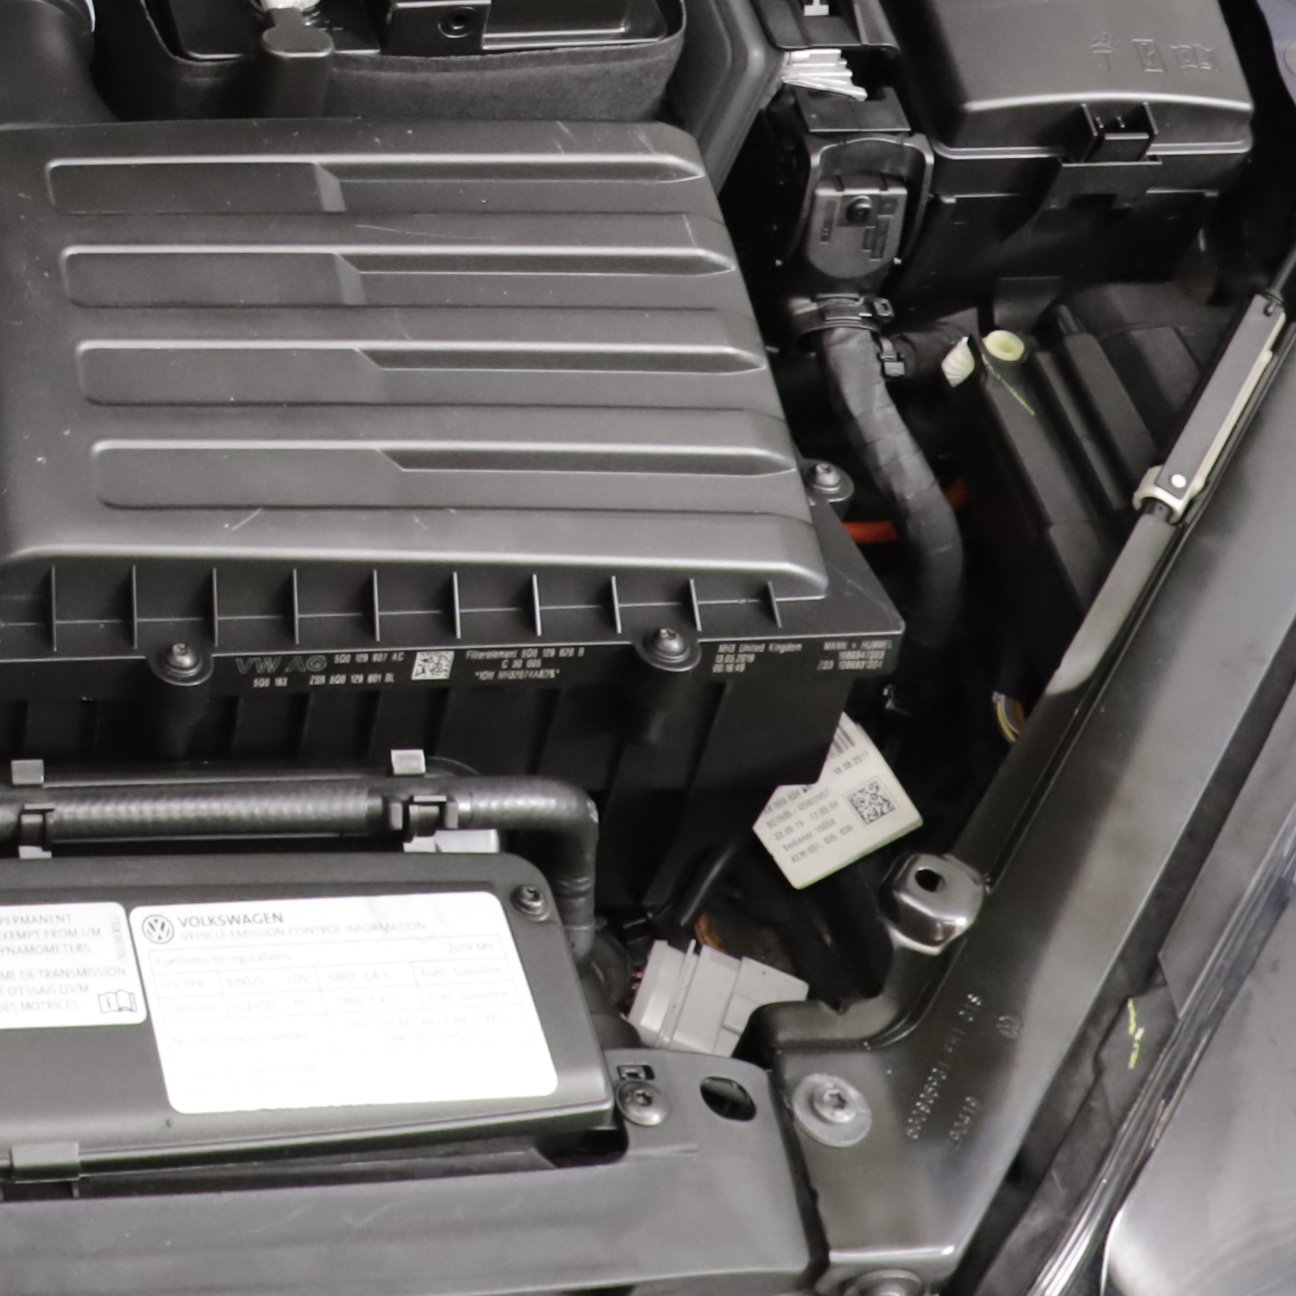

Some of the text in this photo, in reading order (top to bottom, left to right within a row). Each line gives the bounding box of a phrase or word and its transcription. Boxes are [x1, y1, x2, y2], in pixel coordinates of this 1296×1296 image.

[738, 642, 803, 654] United Kingdom
[823, 640, 848, 651] MANN
[235, 654, 328, 674] VW AG
[177, 912, 284, 928] VOLKSWAGEN
[43, 927, 78, 939] FROM
[181, 920, 427, 941] VEHICLE EMISSION CONTROL INFORMATION
[38, 965, 127, 978] TRANSMISSION
